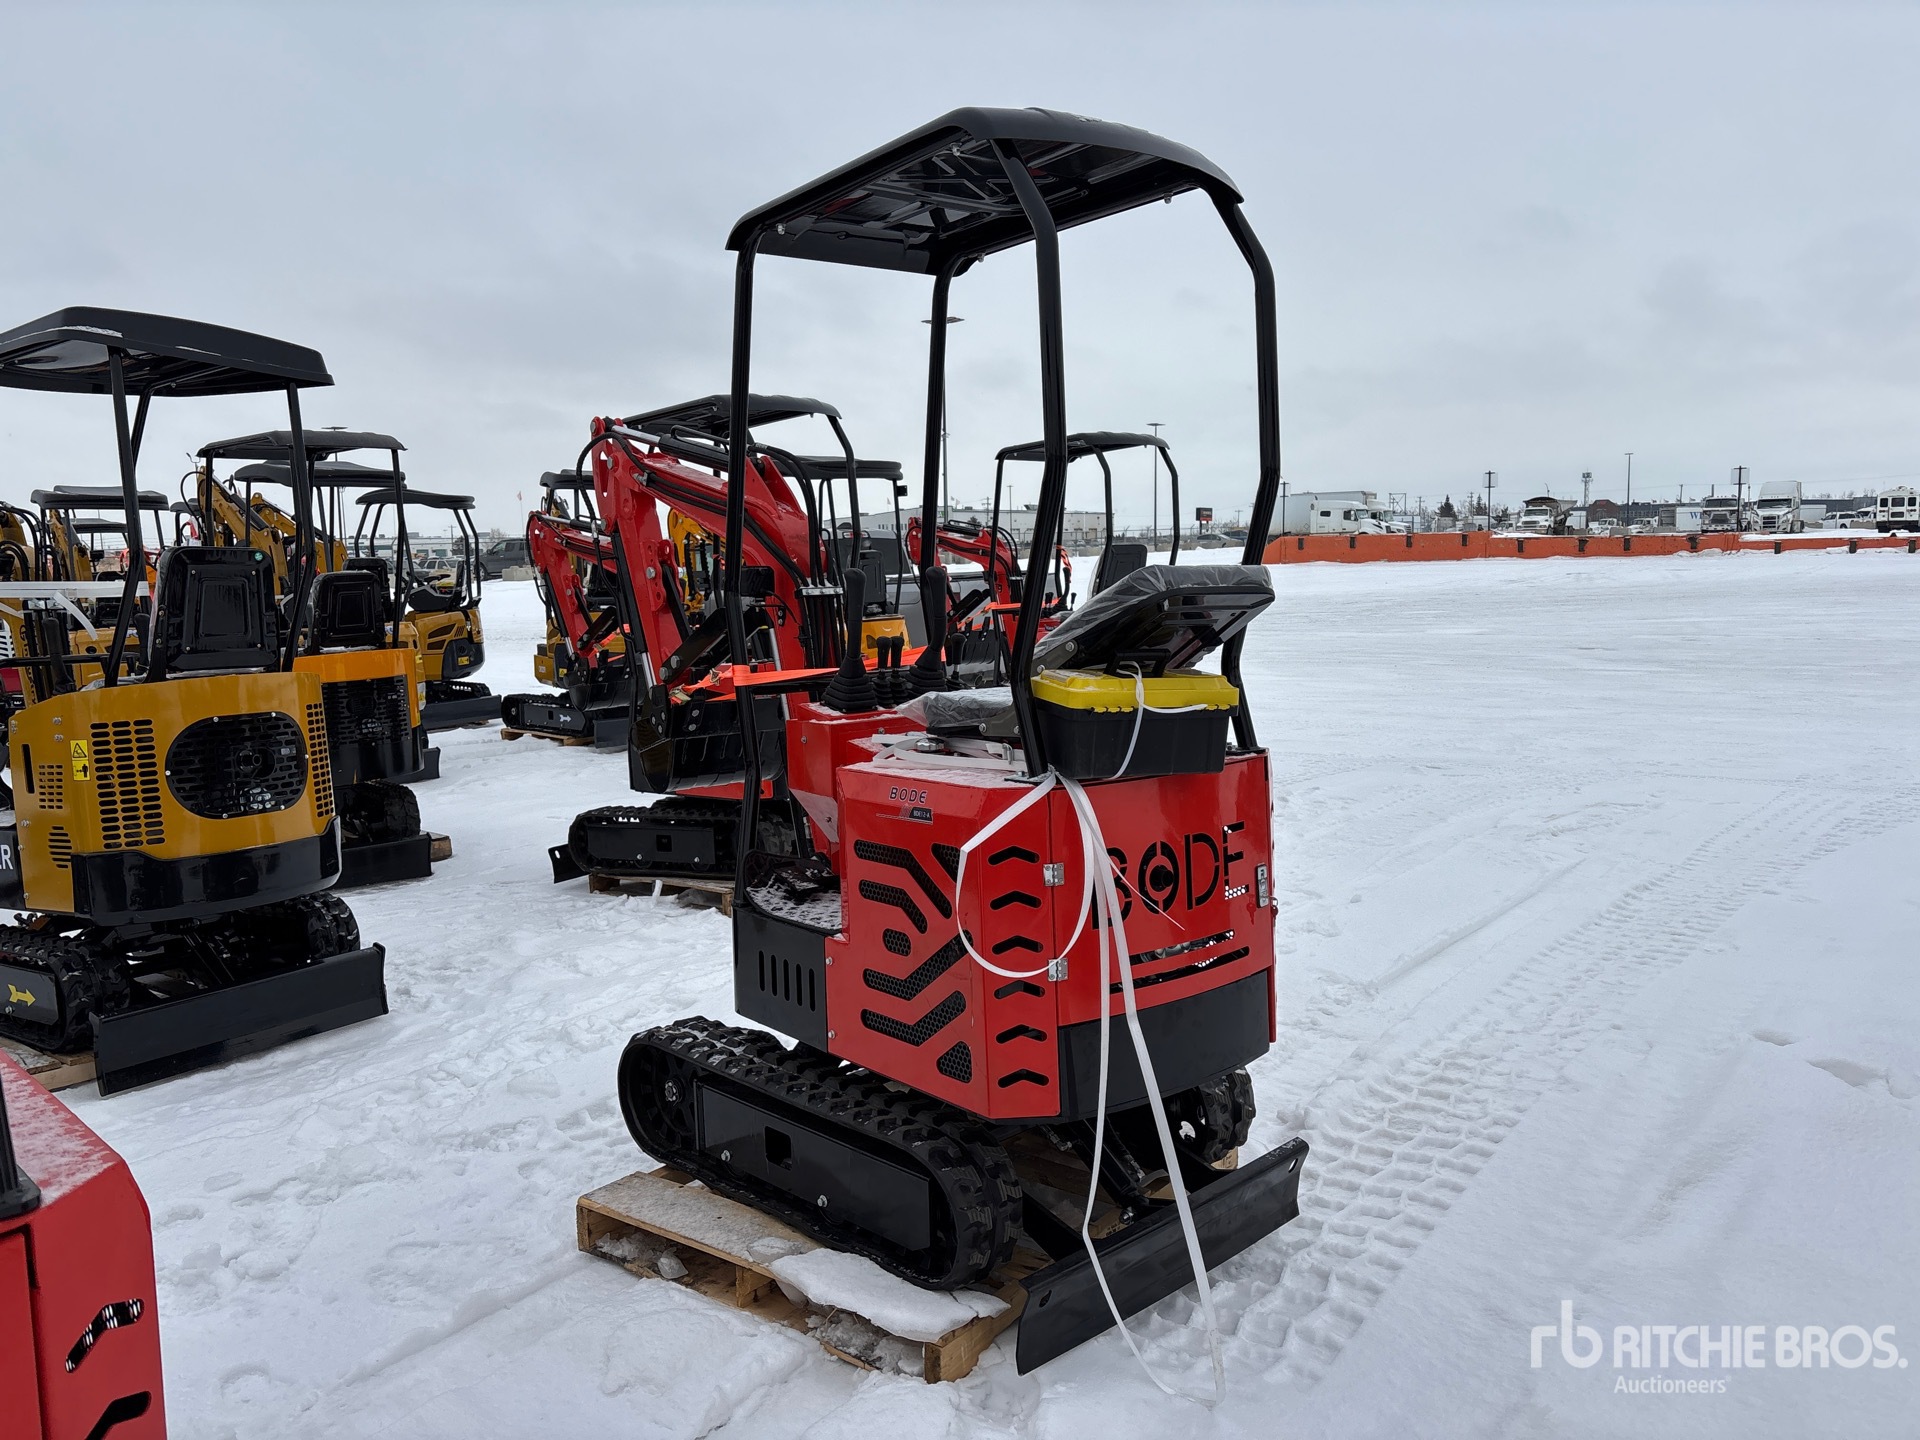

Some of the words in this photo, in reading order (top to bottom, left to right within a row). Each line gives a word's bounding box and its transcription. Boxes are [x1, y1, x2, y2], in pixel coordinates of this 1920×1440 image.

[889, 786, 928, 804] BODE
[0, 844, 14, 870] R
[1092, 821, 1249, 930] BODE
